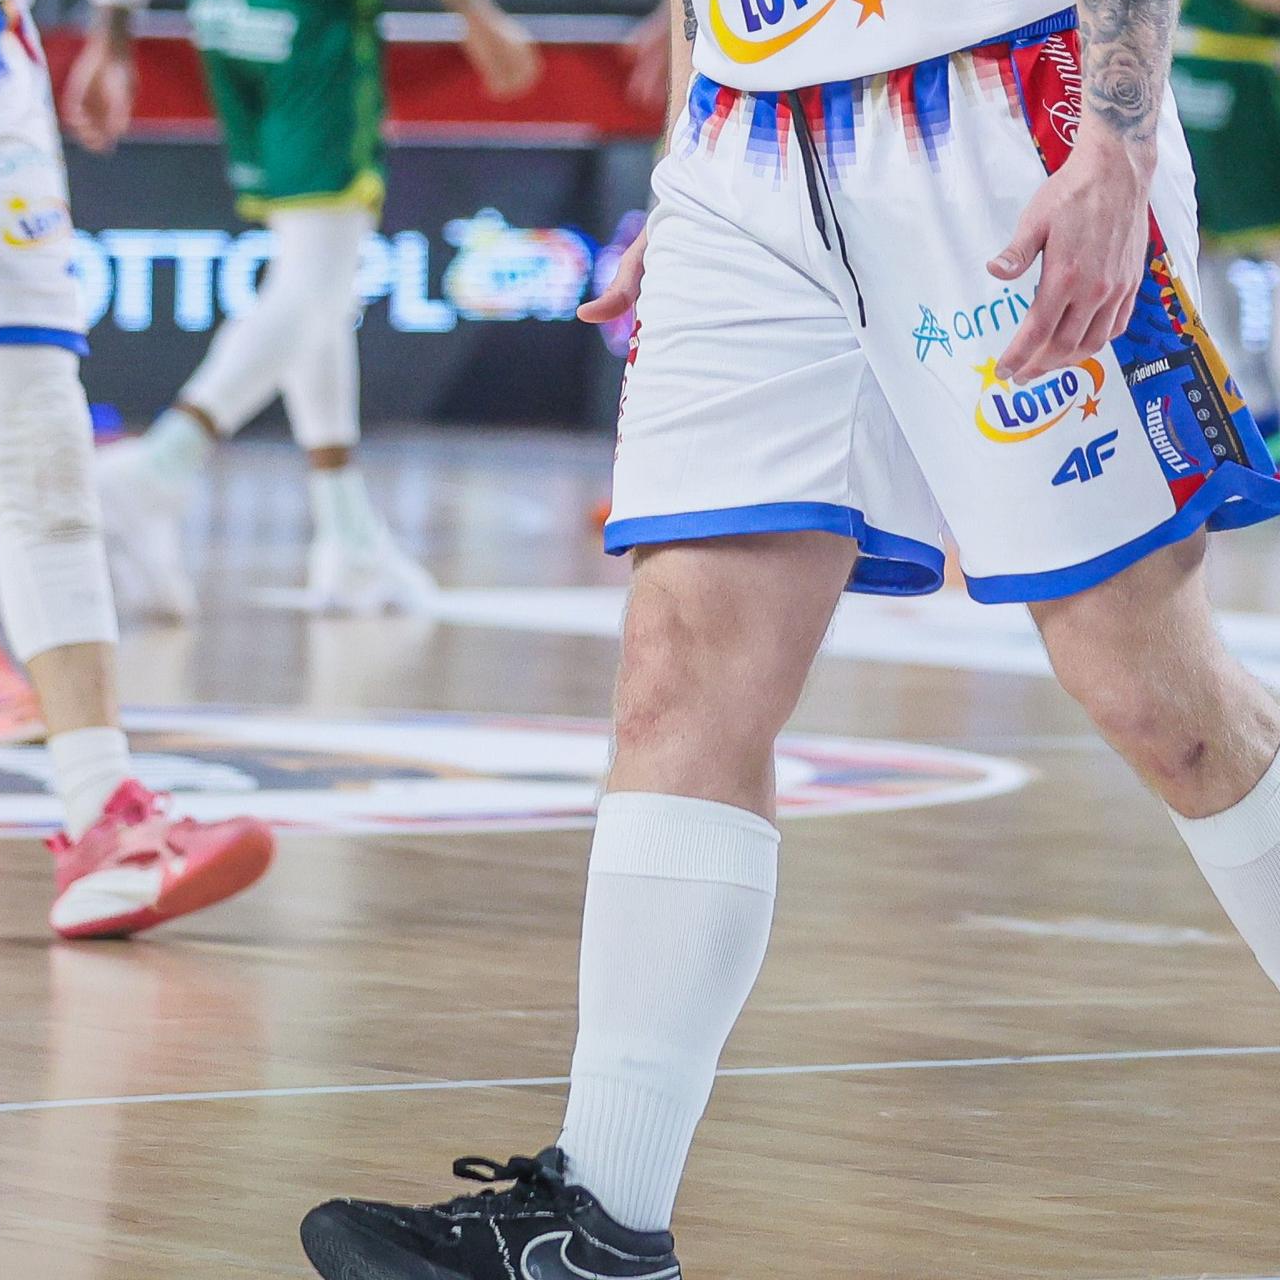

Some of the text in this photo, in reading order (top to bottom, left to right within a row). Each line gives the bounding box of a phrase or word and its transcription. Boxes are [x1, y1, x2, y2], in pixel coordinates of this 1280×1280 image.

[953, 285, 1039, 340] arriv
[992, 370, 1078, 428] LOTTO
[1146, 396, 1190, 474] TWARDE
